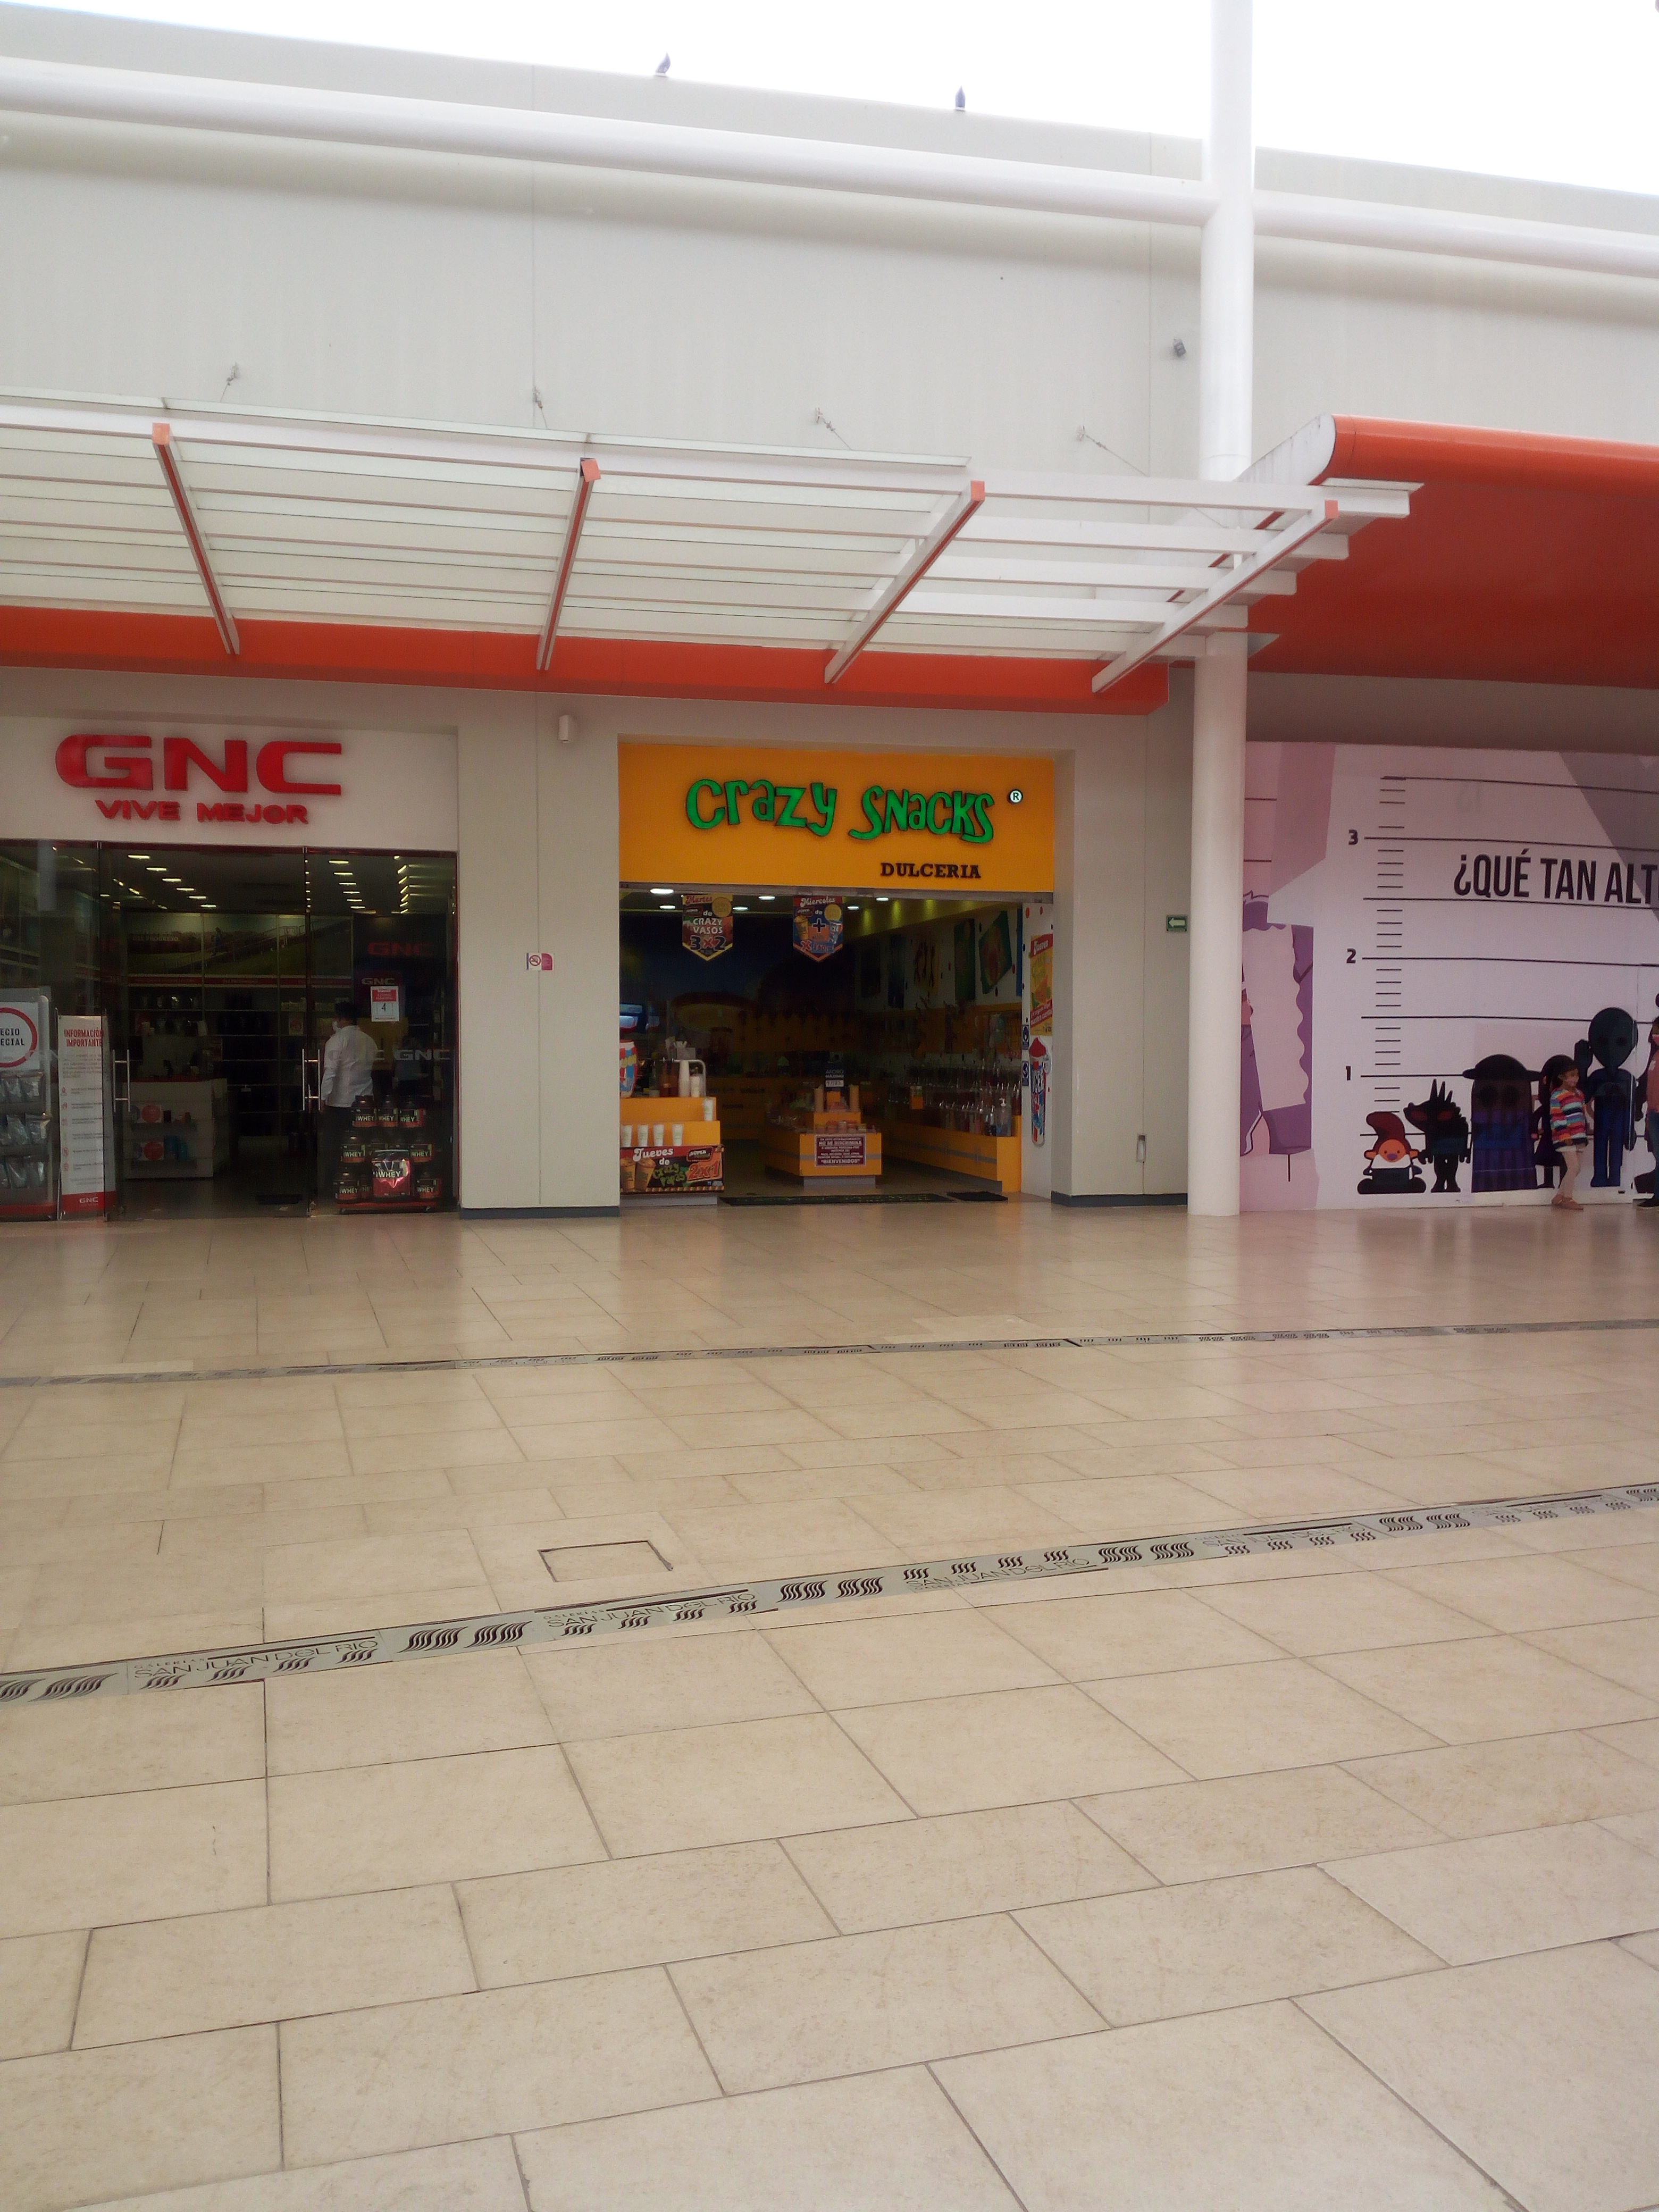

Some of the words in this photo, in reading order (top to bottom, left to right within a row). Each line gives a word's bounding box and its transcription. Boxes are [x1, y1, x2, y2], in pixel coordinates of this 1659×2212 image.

[55, 734, 342, 795] GNC
[95, 800, 181, 820] VIVE
[196, 802, 309, 824] MEJOR
[685, 778, 837, 837] Crazy
[1348, 829, 1359, 845] 3
[880, 862, 982, 878] DULCERIA
[1453, 848, 1531, 898] ¿QUÉ
[1540, 857, 1597, 901] TAN
[1604, 861, 1659, 904] ALT
[1346, 948, 1356, 963] 2
[381, 1003, 386, 1012] 4
[64, 1027, 104, 1037] INFORMACIÓN
[394, 1049, 451, 1061] GNC
[1345, 1066, 1351, 1080] 1
[633, 1147, 674, 1162] Jueves
[547, 1615, 598, 1627] SAN
[600, 1606, 664, 1621] JUAN
[717, 1593, 756, 1605] RIO
[134, 1664, 191, 1678] SAN
[196, 1655, 269, 1671] JUAN
[334, 1640, 378, 1653] RIO
